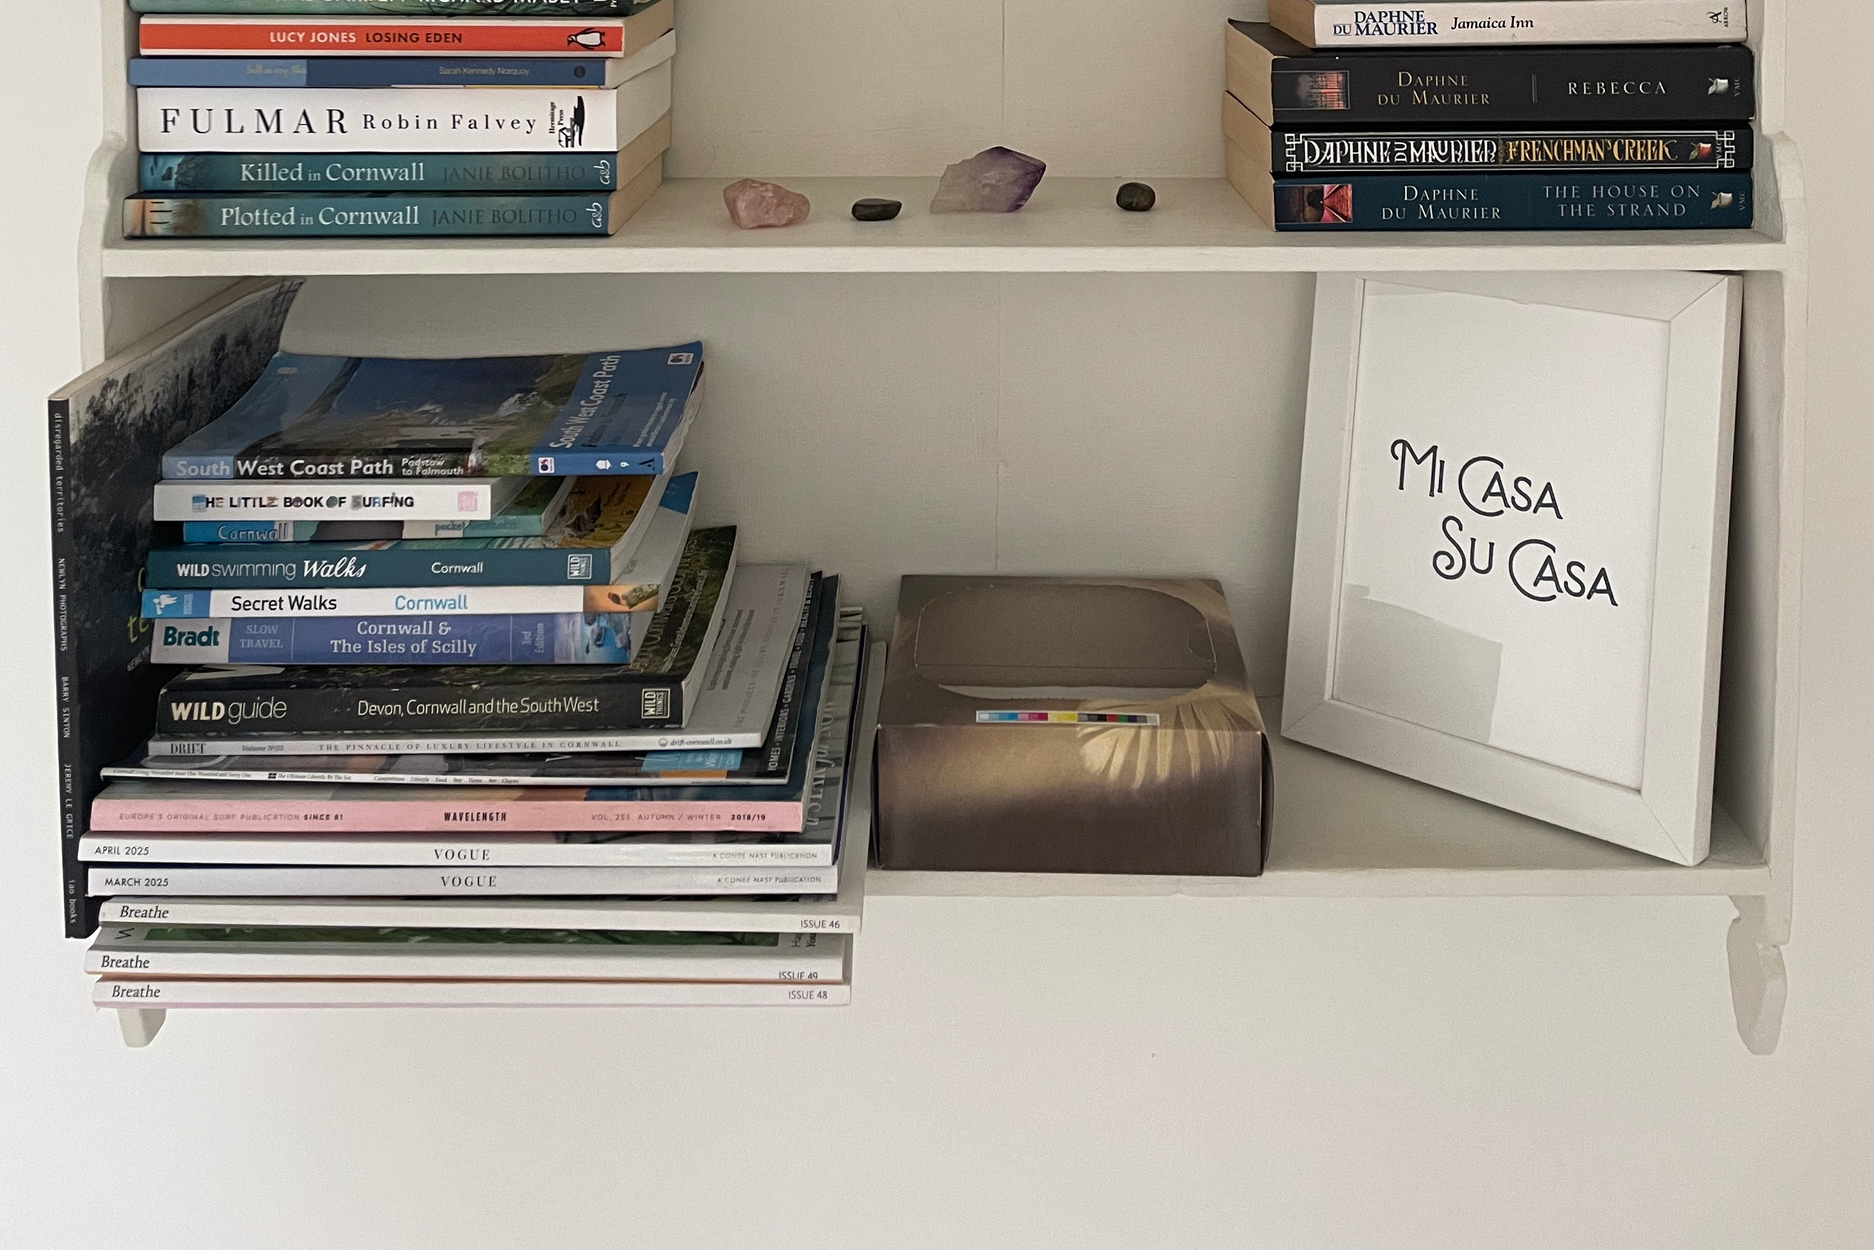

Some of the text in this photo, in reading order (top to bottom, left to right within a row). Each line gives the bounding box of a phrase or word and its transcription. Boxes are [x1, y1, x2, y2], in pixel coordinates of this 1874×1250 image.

[1354, 10, 1425, 23] DAPHNE
[1451, 16, 1534, 30] Jamaica Inn
[1333, 22, 1439, 36] DU MAURIER
[269, 32, 356, 43] LUCY JONES
[365, 32, 462, 44] LOSING EDEN
[1568, 81, 1666, 95] REBECCA
[160, 108, 537, 134] FULMAR Robin Falvey
[548, 101, 556, 134] Hermitage
[1303, 139, 1391, 166] DAPHNE
[1394, 141, 1407, 162] DU
[1410, 139, 1497, 165] MAURIER
[1612, 138, 1679, 162] CREEK
[240, 162, 586, 183] Killed in Cornwall JANIE BOLITHO
[1543, 185, 1701, 199] THE HOUSE ON
[220, 206, 578, 227] Plotted in Cornwall JANIE BOLITHO
[1557, 203, 1687, 217] THE STRAND
[592, 355, 622, 378] Path
[580, 379, 612, 406] Coast
[176, 459, 394, 477] South West Coast Path
[401, 456, 446, 467] Padstow
[415, 466, 464, 476] Falmouth
[229, 496, 279, 509] LITTLE
[283, 496, 324, 508] BOOK
[351, 493, 414, 511] SURFING
[217, 525, 289, 541] Cornwall
[177, 556, 484, 581] WILD swimming Walks Cornwall
[230, 594, 468, 611] Secret Walks Cornwall
[246, 624, 279, 634] SLOW
[356, 621, 451, 636] Cornwall &
[163, 625, 220, 647] Bradt
[521, 631, 532, 645] 3rd
[535, 622, 545, 654] Edition
[240, 639, 284, 649] TRAVEL
[330, 639, 477, 656] The Isles of Scilly
[53, 412, 78, 924] disregarded territories NEWLYN PHOTOGRAPHS BARRY SINTON JEREMY LE GRICE books
[171, 696, 288, 725] WILD guide
[357, 697, 600, 718] Devon, Cornwall and the South West
[644, 692, 656, 716] WILD
[170, 743, 206, 754] DRIFT
[345, 740, 621, 751] PINNACLE LUXURY LIFESTYLE CORNWALL
[166, 813, 331, 821] ORIGINAL PUBLICATION SINCE
[443, 812, 507, 822] WAVELENGTH
[637, 813, 766, 822] AUTUMN WINTER 2018/19
[94, 846, 149, 856] APRIL 2025
[434, 848, 490, 861] VOGUE
[104, 877, 169, 887] MARCH 2025
[441, 876, 497, 888] VOGUE
[120, 905, 169, 919] Breathe
[800, 919, 840, 929] ISSUE 46
[101, 955, 150, 969] Breathe
[112, 985, 161, 998] Breathe
[788, 990, 828, 999] ISSUE 48
